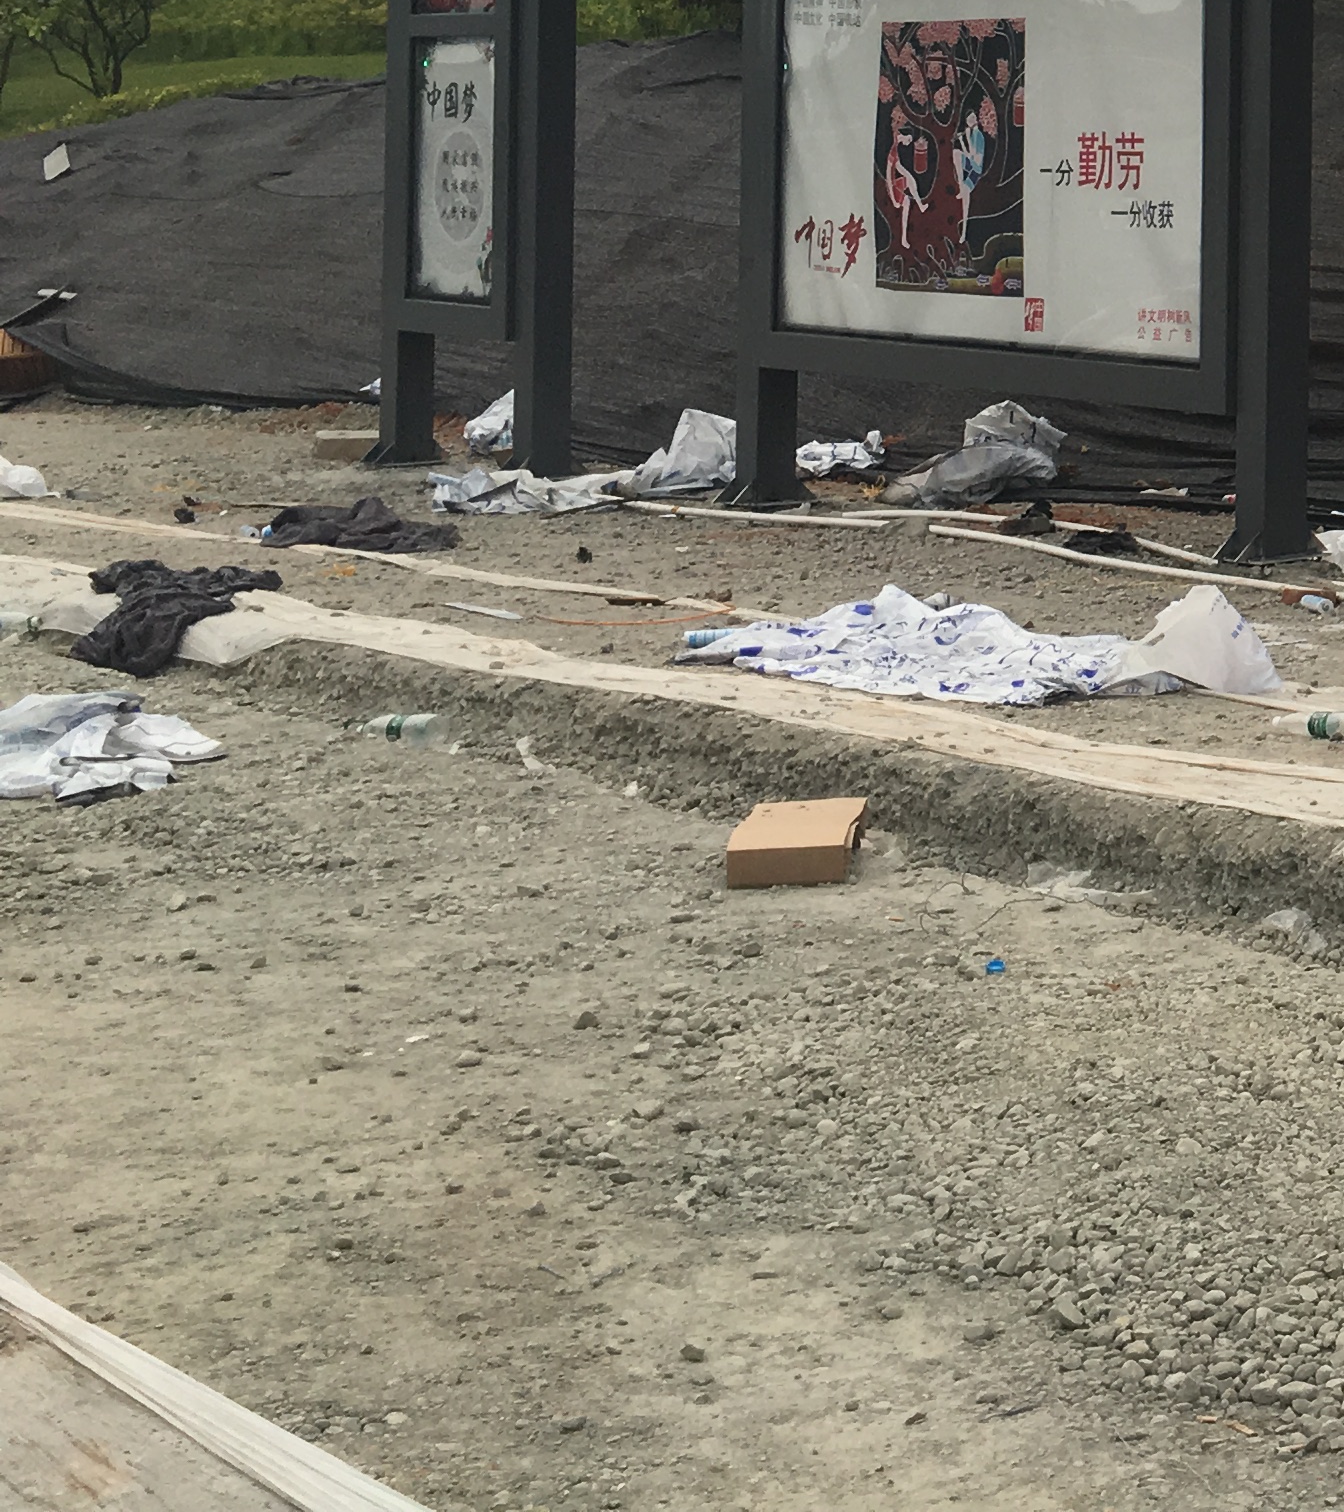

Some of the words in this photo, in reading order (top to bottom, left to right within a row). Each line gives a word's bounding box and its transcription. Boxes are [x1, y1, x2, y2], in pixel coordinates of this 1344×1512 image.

[427, 80, 478, 124] 中国梦
[1111, 200, 1175, 229] 一分收获
